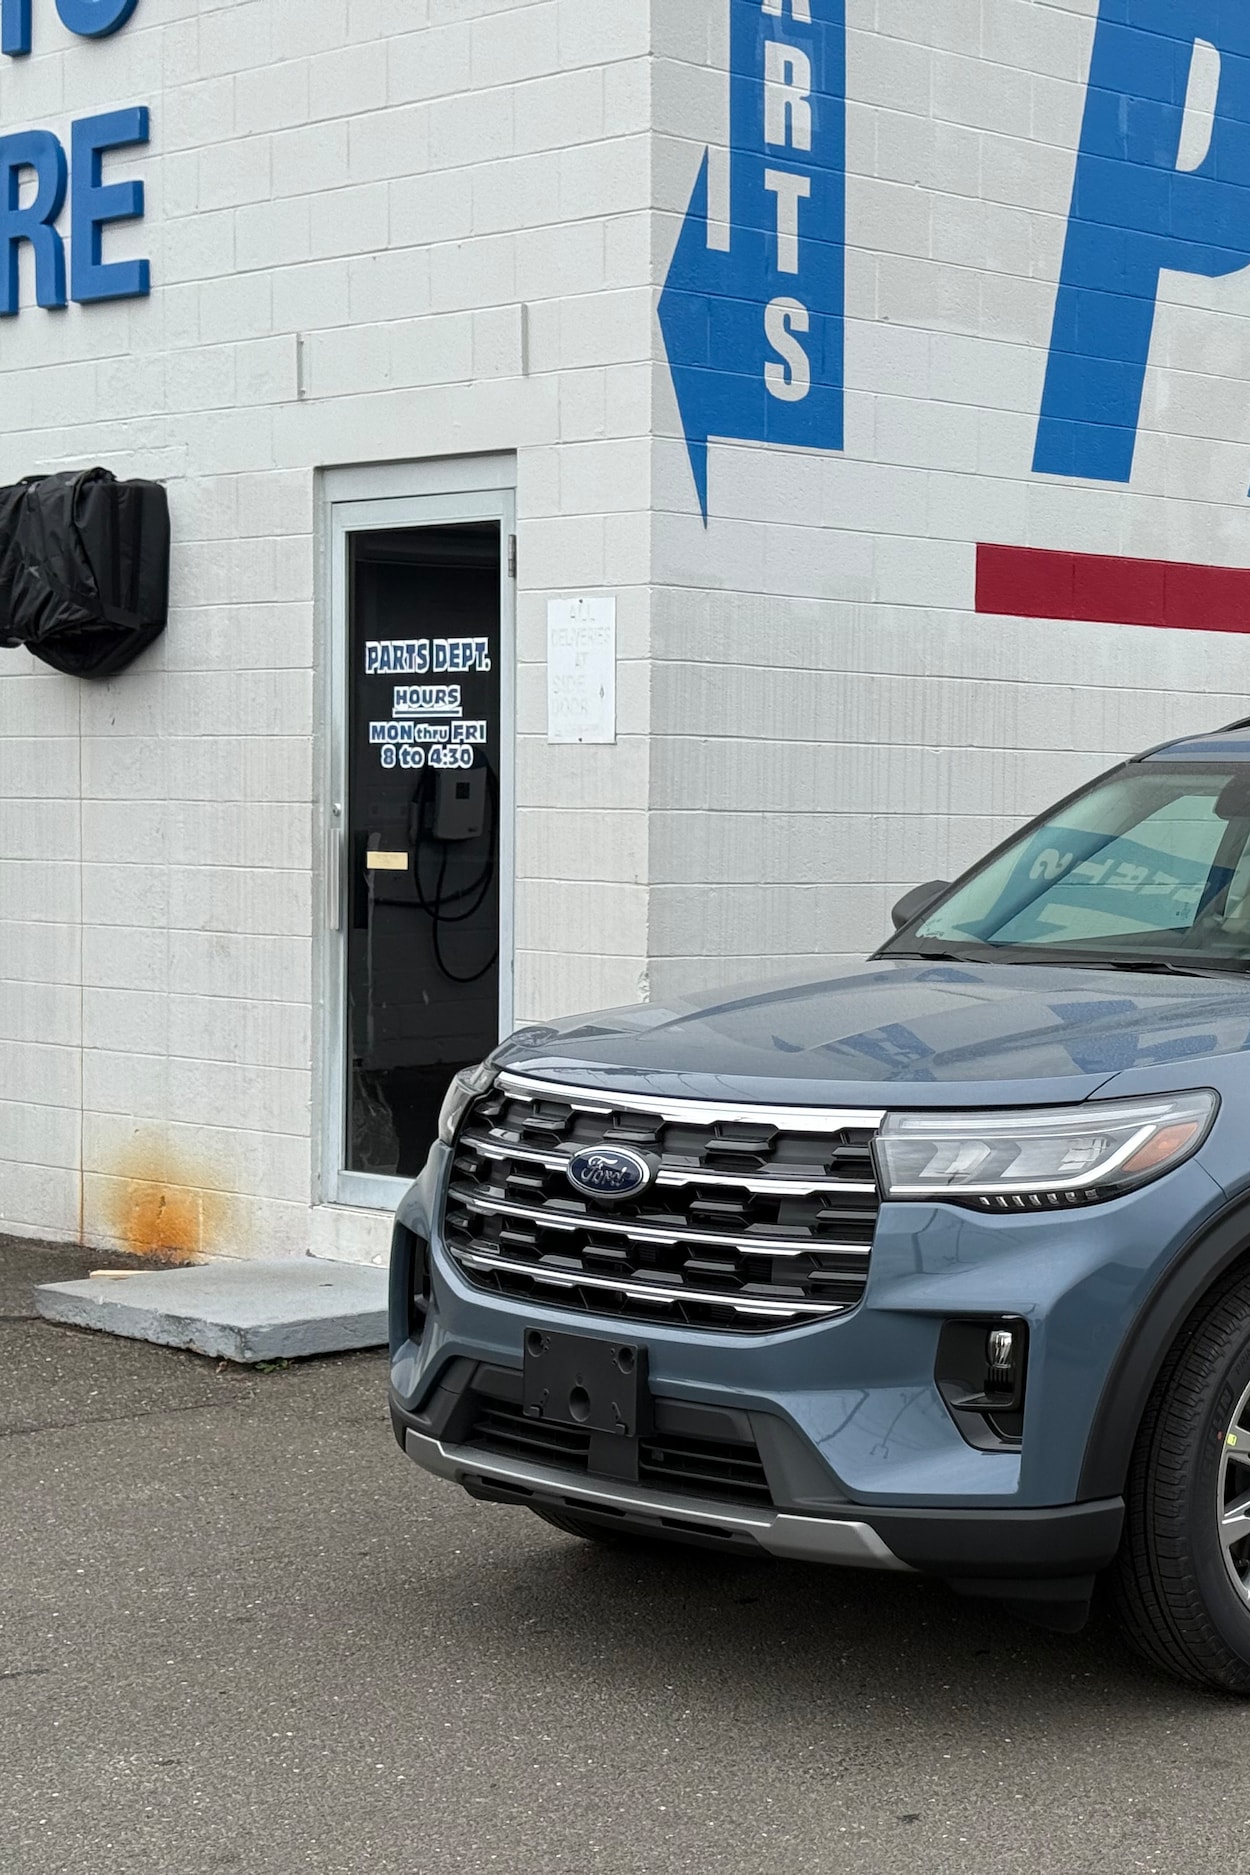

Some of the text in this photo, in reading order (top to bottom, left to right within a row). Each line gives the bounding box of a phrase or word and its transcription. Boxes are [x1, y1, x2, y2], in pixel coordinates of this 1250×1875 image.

[763, 0, 812, 402] RTS
[366, 637, 492, 674] PARTS DEPT.
[394, 685, 461, 708] HOURS
[369, 720, 487, 743] MON thru FRI
[381, 744, 473, 768] 8 to 4:30
[580, 1155, 628, 1187] Ford
